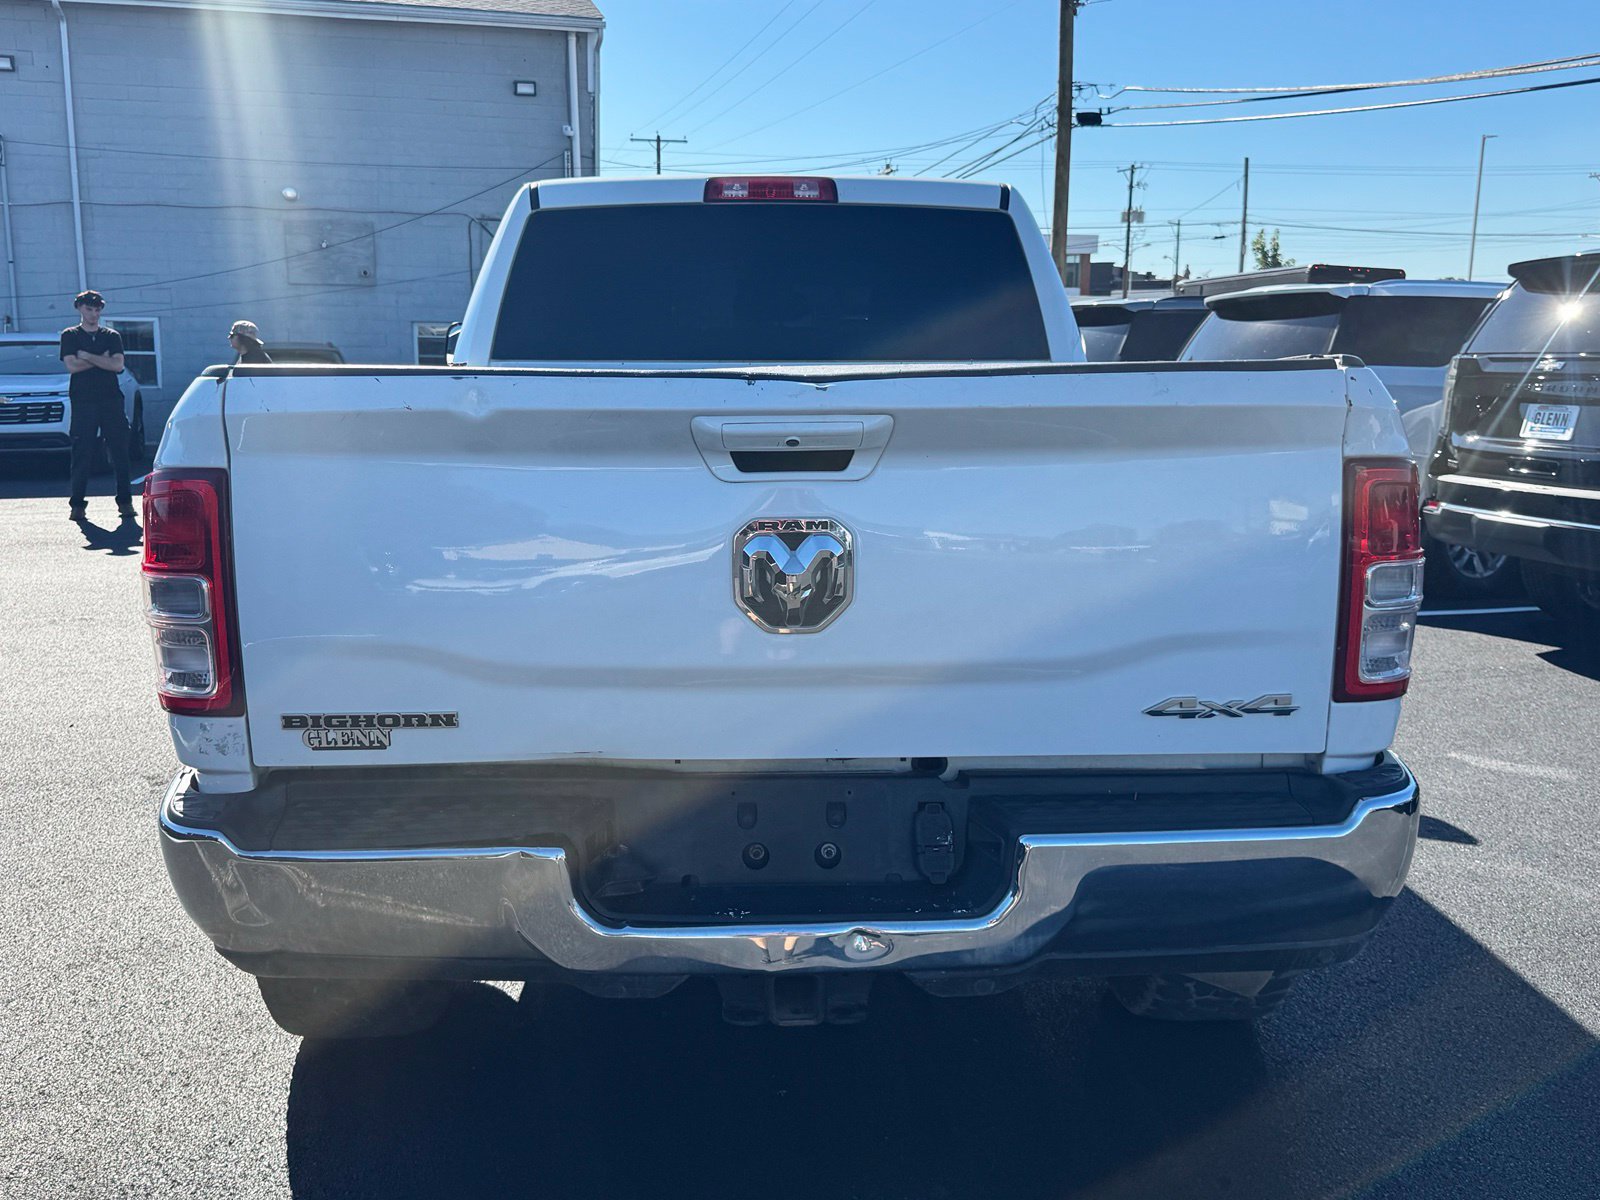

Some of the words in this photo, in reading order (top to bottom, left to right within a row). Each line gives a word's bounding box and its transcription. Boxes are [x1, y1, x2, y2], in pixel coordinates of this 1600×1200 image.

[1533, 412, 1569, 427] GLENN
[756, 520, 830, 531] RAM
[281, 712, 459, 730] BIGHORN
[302, 728, 392, 750] GLENN
